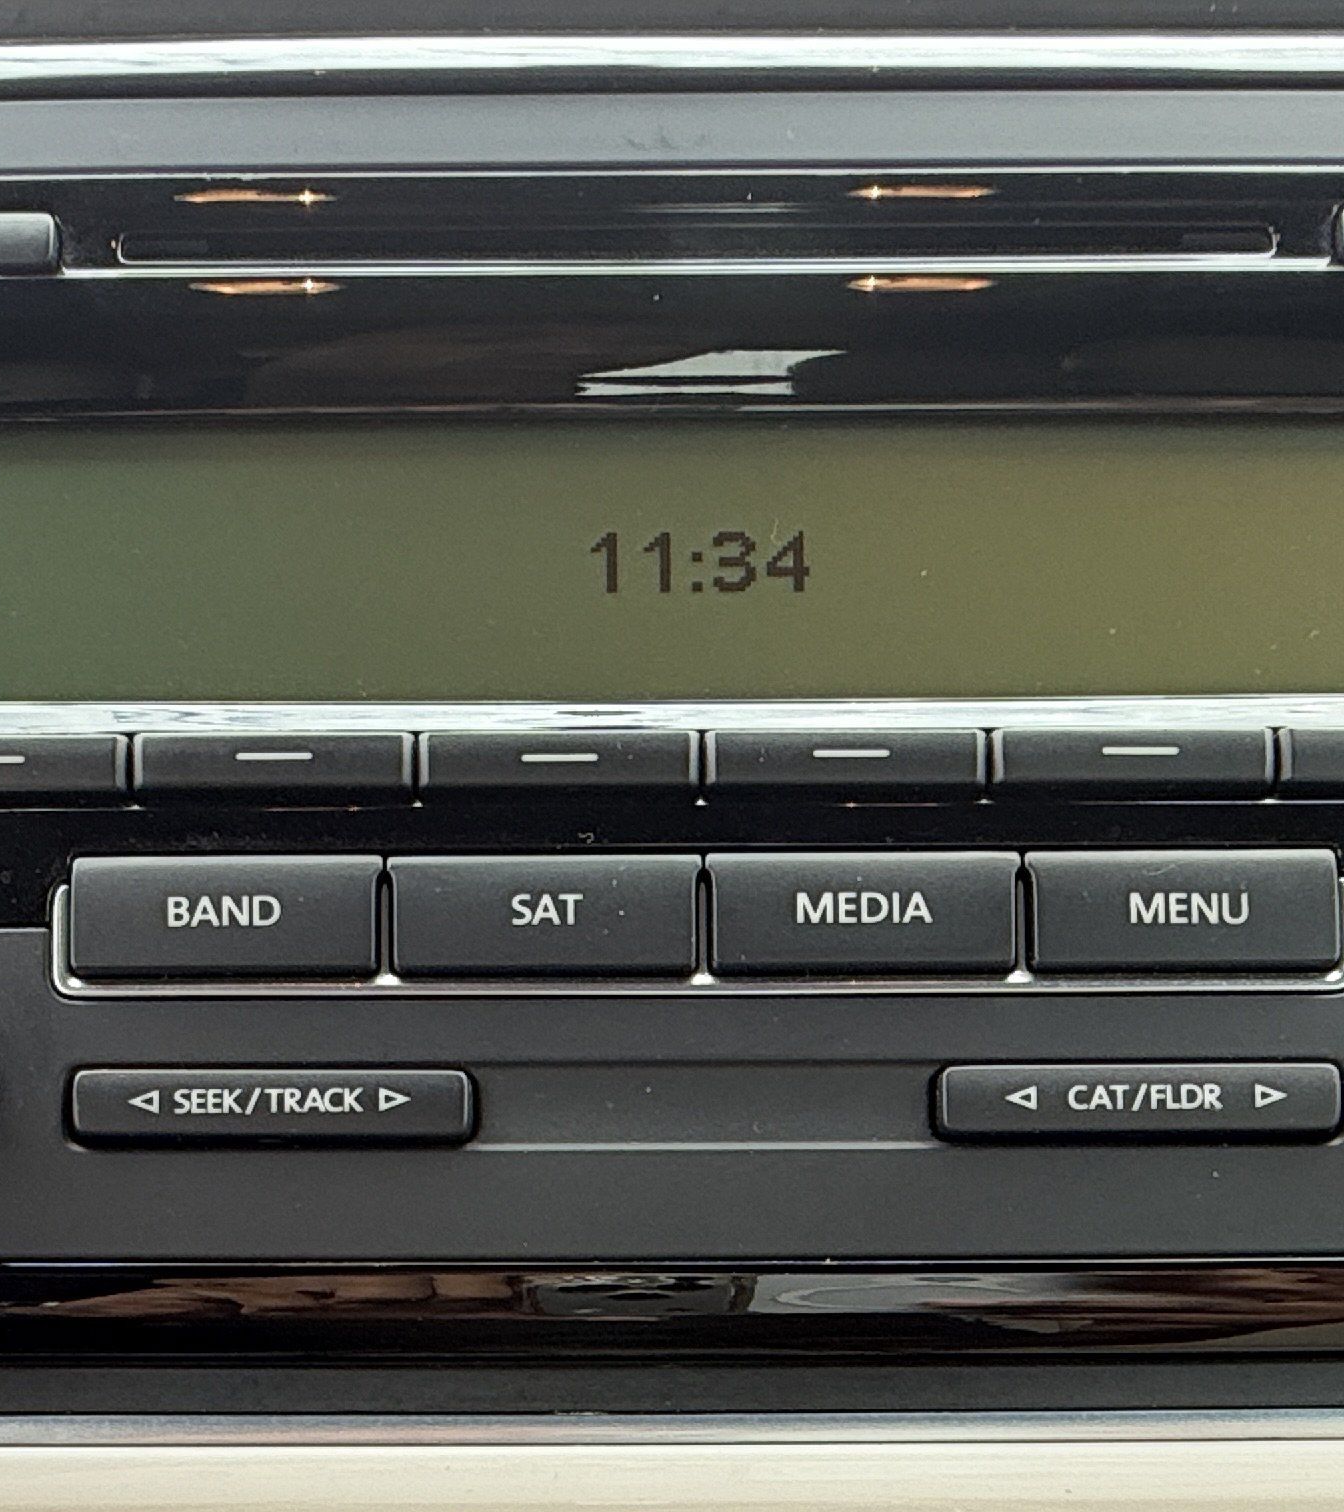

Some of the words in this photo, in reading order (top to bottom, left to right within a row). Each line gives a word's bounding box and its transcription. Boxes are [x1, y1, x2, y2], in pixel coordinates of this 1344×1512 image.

[589, 530, 810, 593] 11:34
[166, 895, 283, 928] BAND
[510, 893, 584, 926] SAT
[795, 891, 934, 925] MEDIA
[1128, 891, 1251, 925] MENU
[172, 1087, 364, 1116] SEEK/TRACK
[1067, 1084, 1224, 1112] CAT/FLDR
